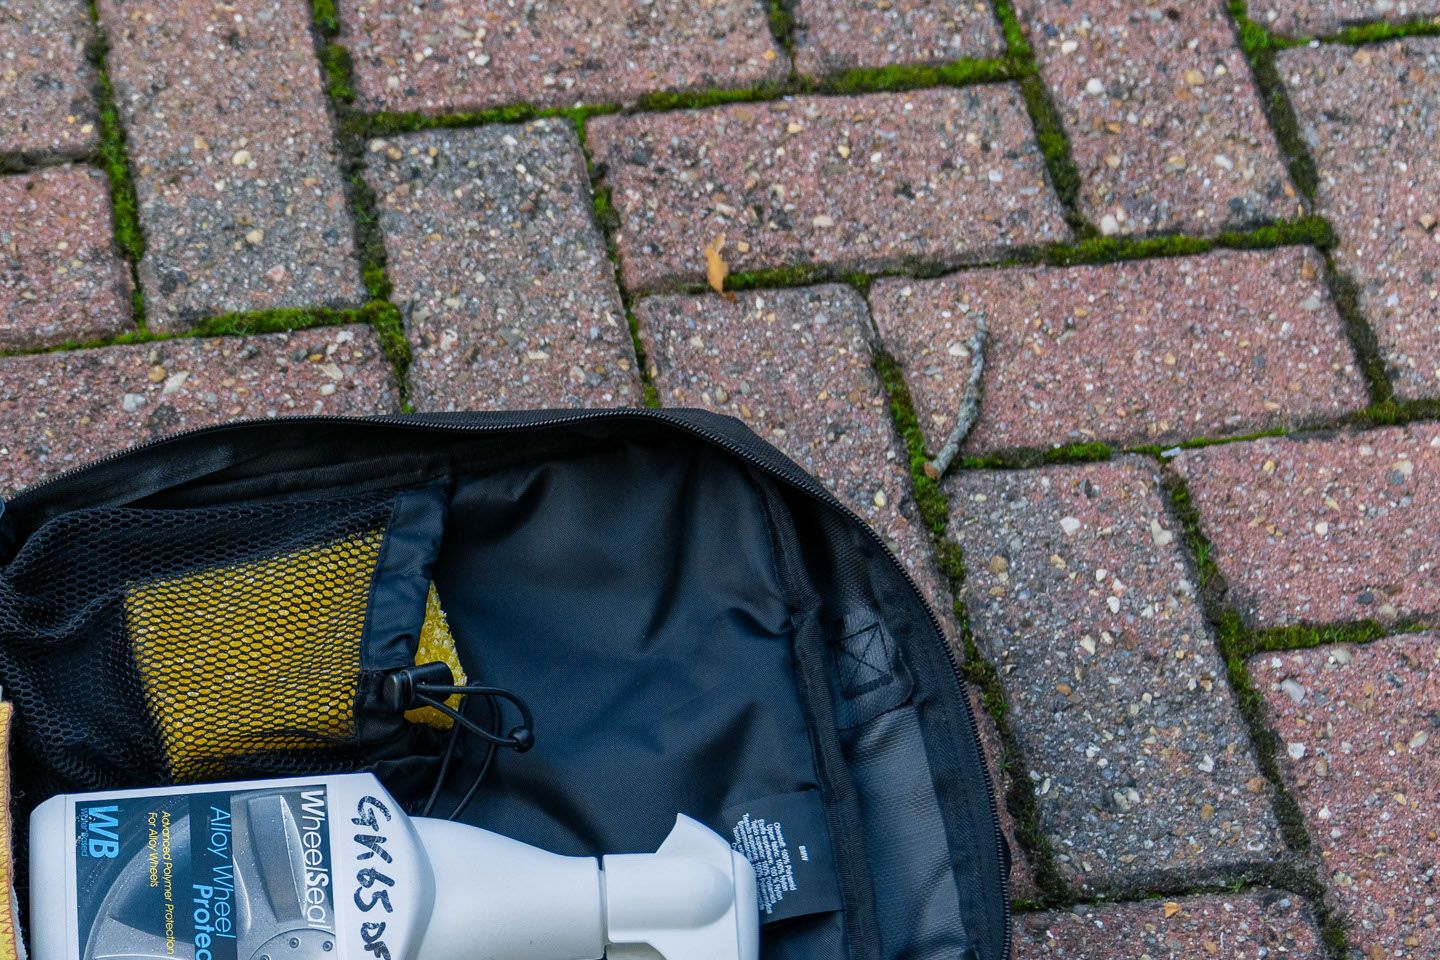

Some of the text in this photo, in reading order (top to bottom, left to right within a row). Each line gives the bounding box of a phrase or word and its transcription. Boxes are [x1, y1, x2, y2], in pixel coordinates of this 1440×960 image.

[81, 808, 89, 857] Water Based
[88, 805, 120, 859] WB
[147, 812, 159, 888] For Alloy Wheels
[300, 790, 332, 930] WheelSeal
[799, 845, 809, 861] BMW
[161, 811, 176, 955] Advanced Polymer Protection
[207, 806, 237, 939] Alloy Wheel
